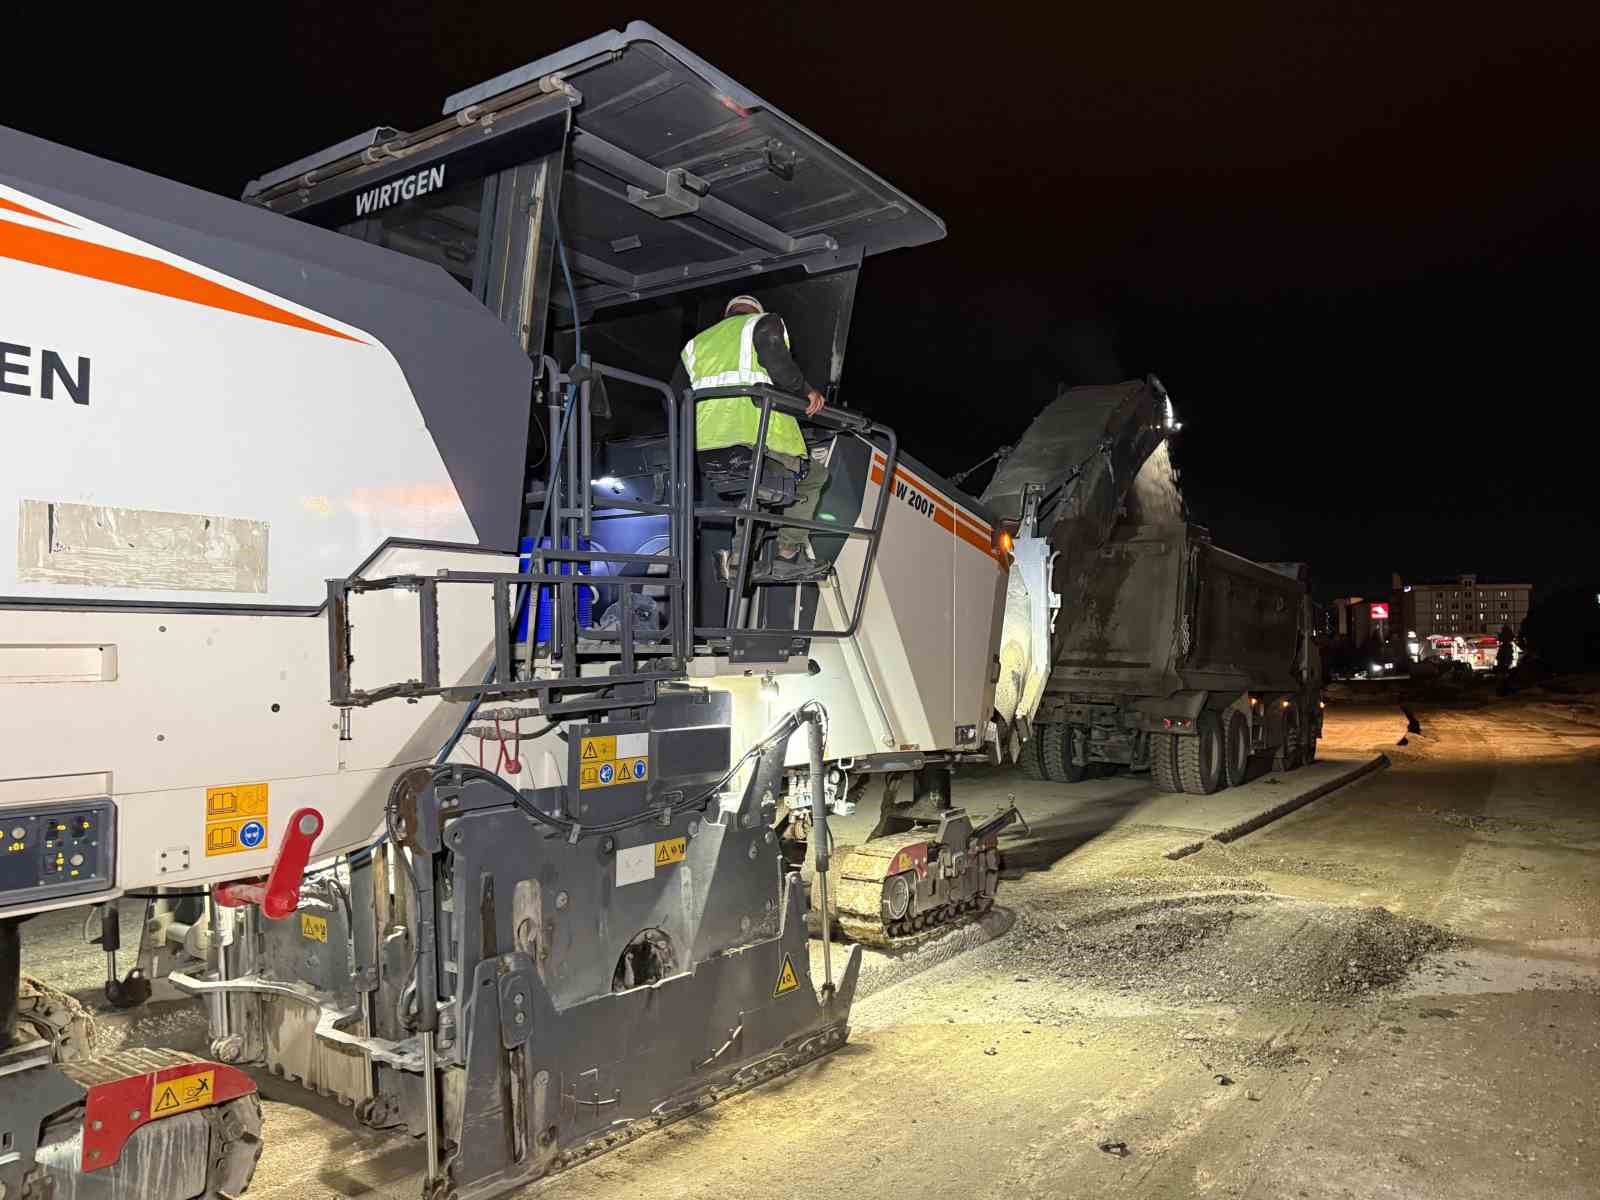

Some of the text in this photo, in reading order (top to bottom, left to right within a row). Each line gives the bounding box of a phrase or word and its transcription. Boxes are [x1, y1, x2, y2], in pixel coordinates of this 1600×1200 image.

[355, 163, 446, 217] WIRTGEN
[0, 341, 91, 406] EN
[895, 481, 908, 501] W
